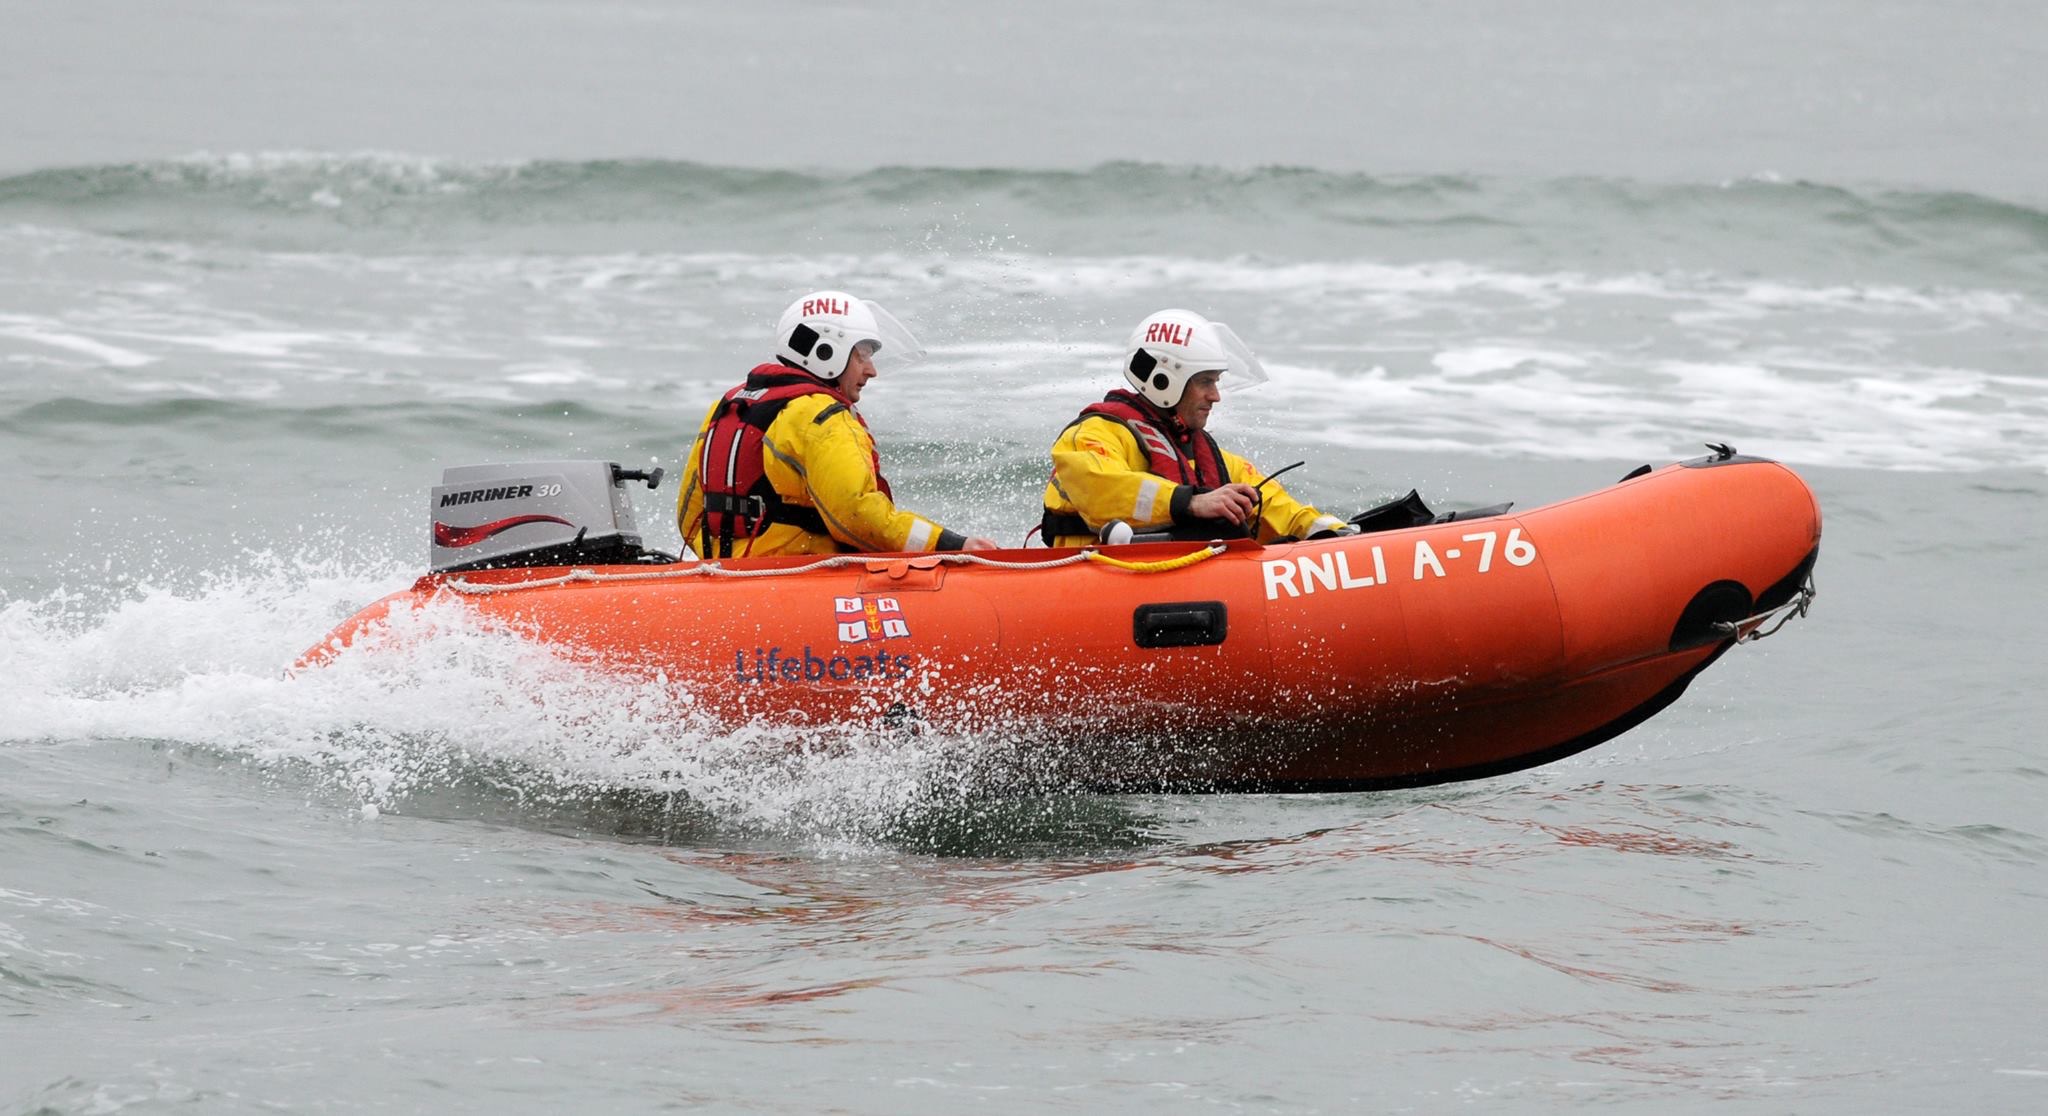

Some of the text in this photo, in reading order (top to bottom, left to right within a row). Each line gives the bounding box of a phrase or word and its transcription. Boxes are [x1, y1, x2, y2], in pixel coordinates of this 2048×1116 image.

[802, 298, 849, 317] RNLI
[1145, 322, 1193, 347] RNLI
[440, 483, 563, 508] MARINER 30
[1262, 528, 1536, 600] RNLI A-76
[844, 601, 893, 611] R N
[848, 626, 859, 639] L
[735, 646, 911, 683] Lifeboats
